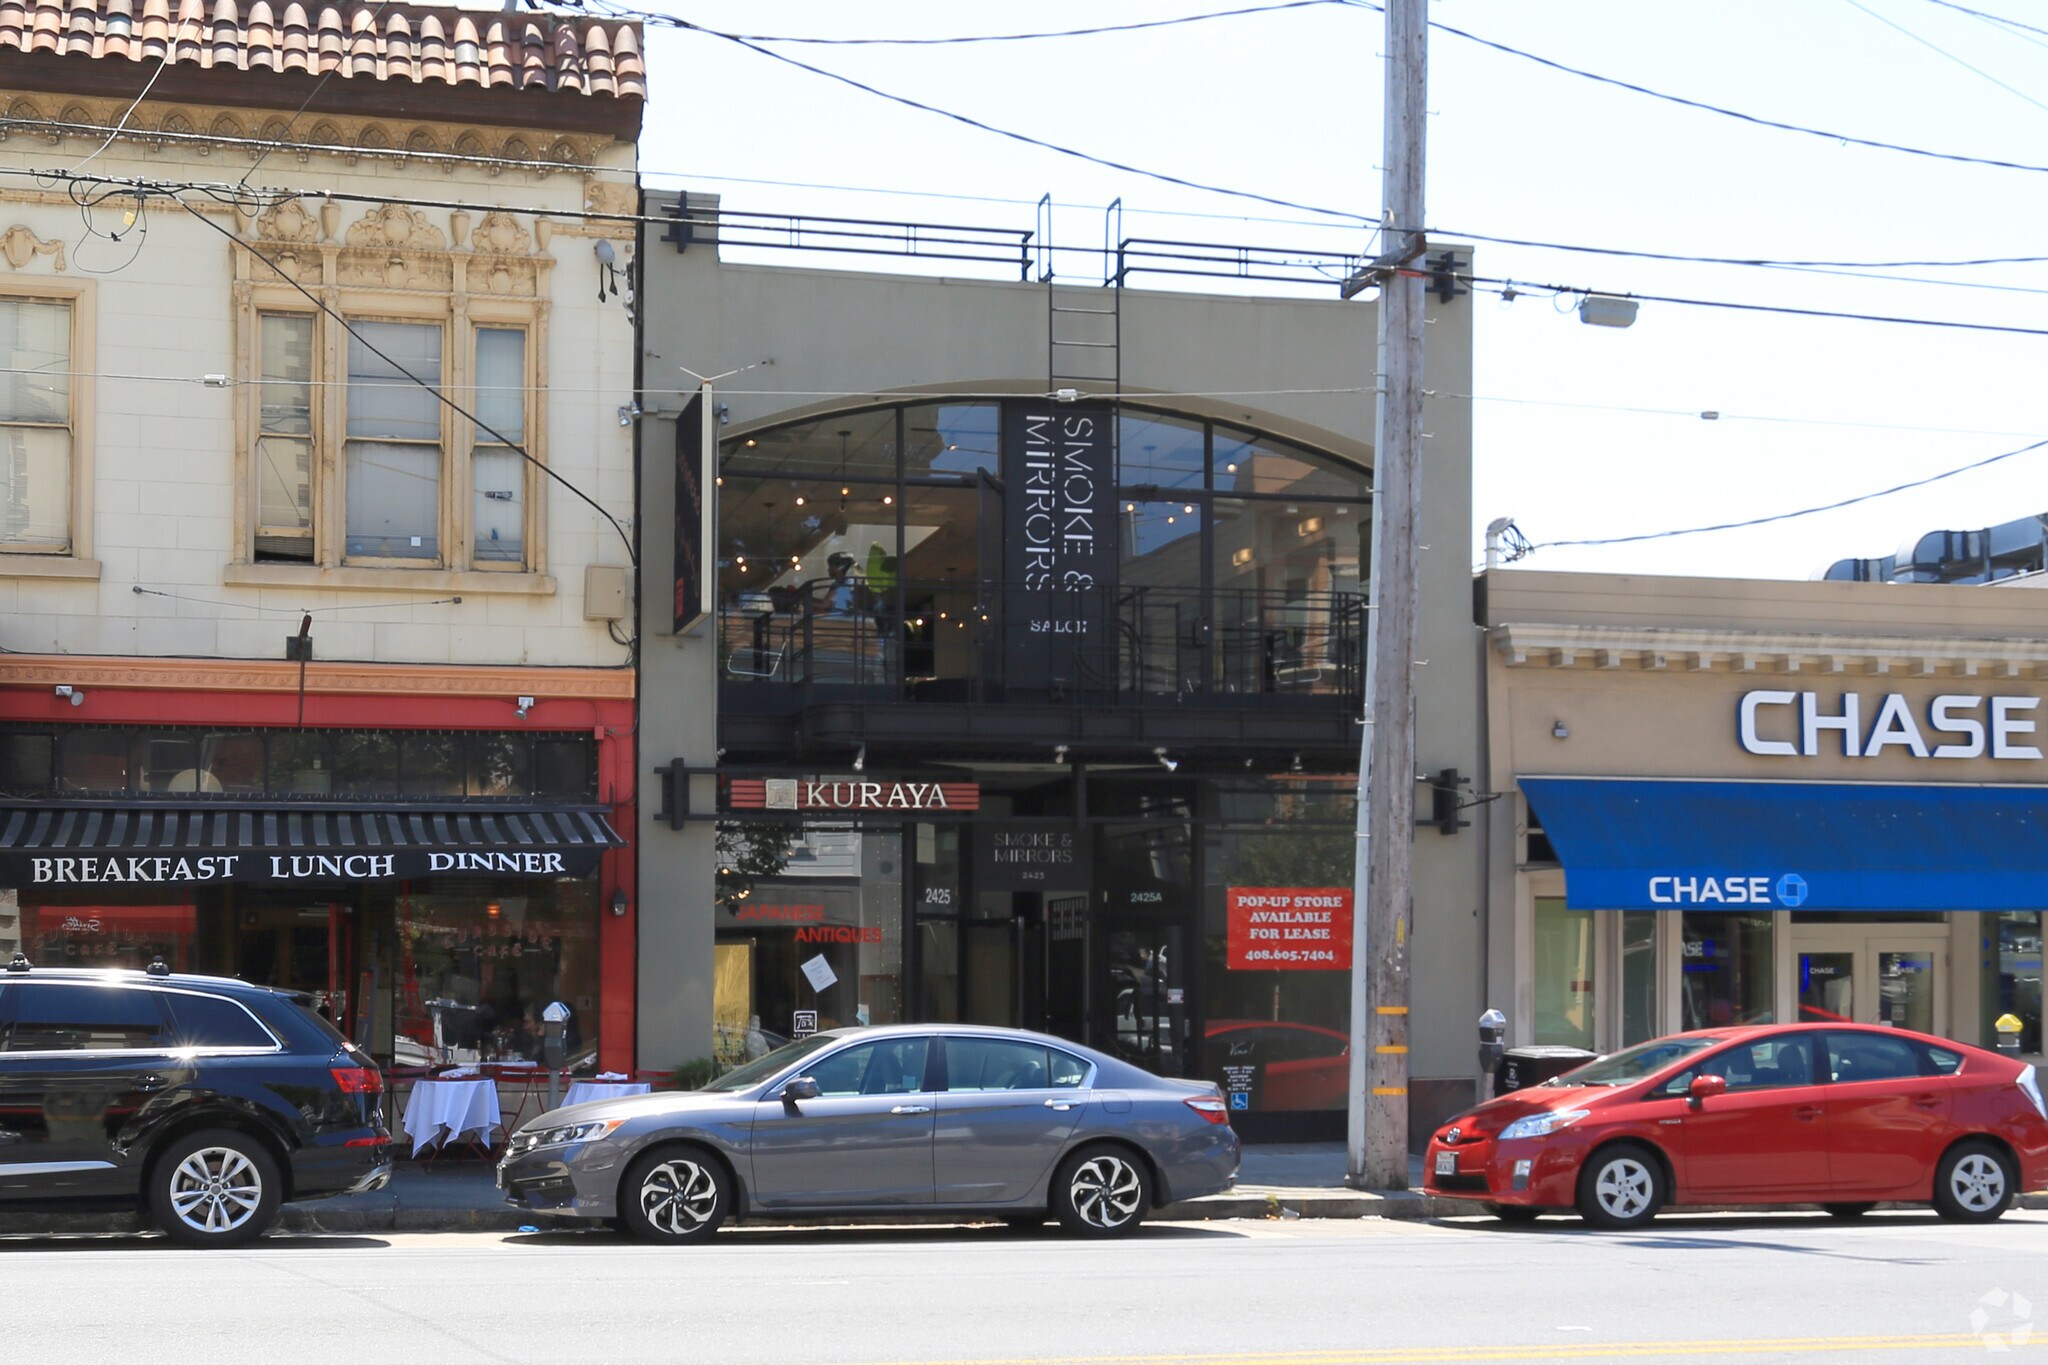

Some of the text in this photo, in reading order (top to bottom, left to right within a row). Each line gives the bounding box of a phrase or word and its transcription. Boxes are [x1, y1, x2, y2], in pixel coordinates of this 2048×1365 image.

[1026, 416, 1055, 591] MIRRORS
[1064, 417, 1093, 592] SMOKE &
[1739, 690, 2044, 759] CHASE
[805, 782, 949, 808] KURAYA
[994, 833, 1072, 847] SMOKE &
[428, 852, 566, 873] DINNER
[994, 849, 1072, 863] MIRRORS
[31, 855, 239, 883] BREAKFAST
[270, 854, 395, 878] LUNCH
[1022, 871, 1045, 880] 2423
[925, 888, 951, 904] 2425
[1130, 892, 1162, 903] 2425A
[1649, 876, 1771, 903] CHASE
[1237, 896, 1342, 907] POP-UP STORE
[735, 905, 824, 921] JAPANESE
[1250, 912, 1331, 923] AVAILABLE
[794, 927, 883, 943] ANTIQUES
[1250, 929, 1330, 939] FOR LEASE
[1245, 950, 1334, 961] 408.605.7404
[1809, 967, 1835, 975] CHASE
